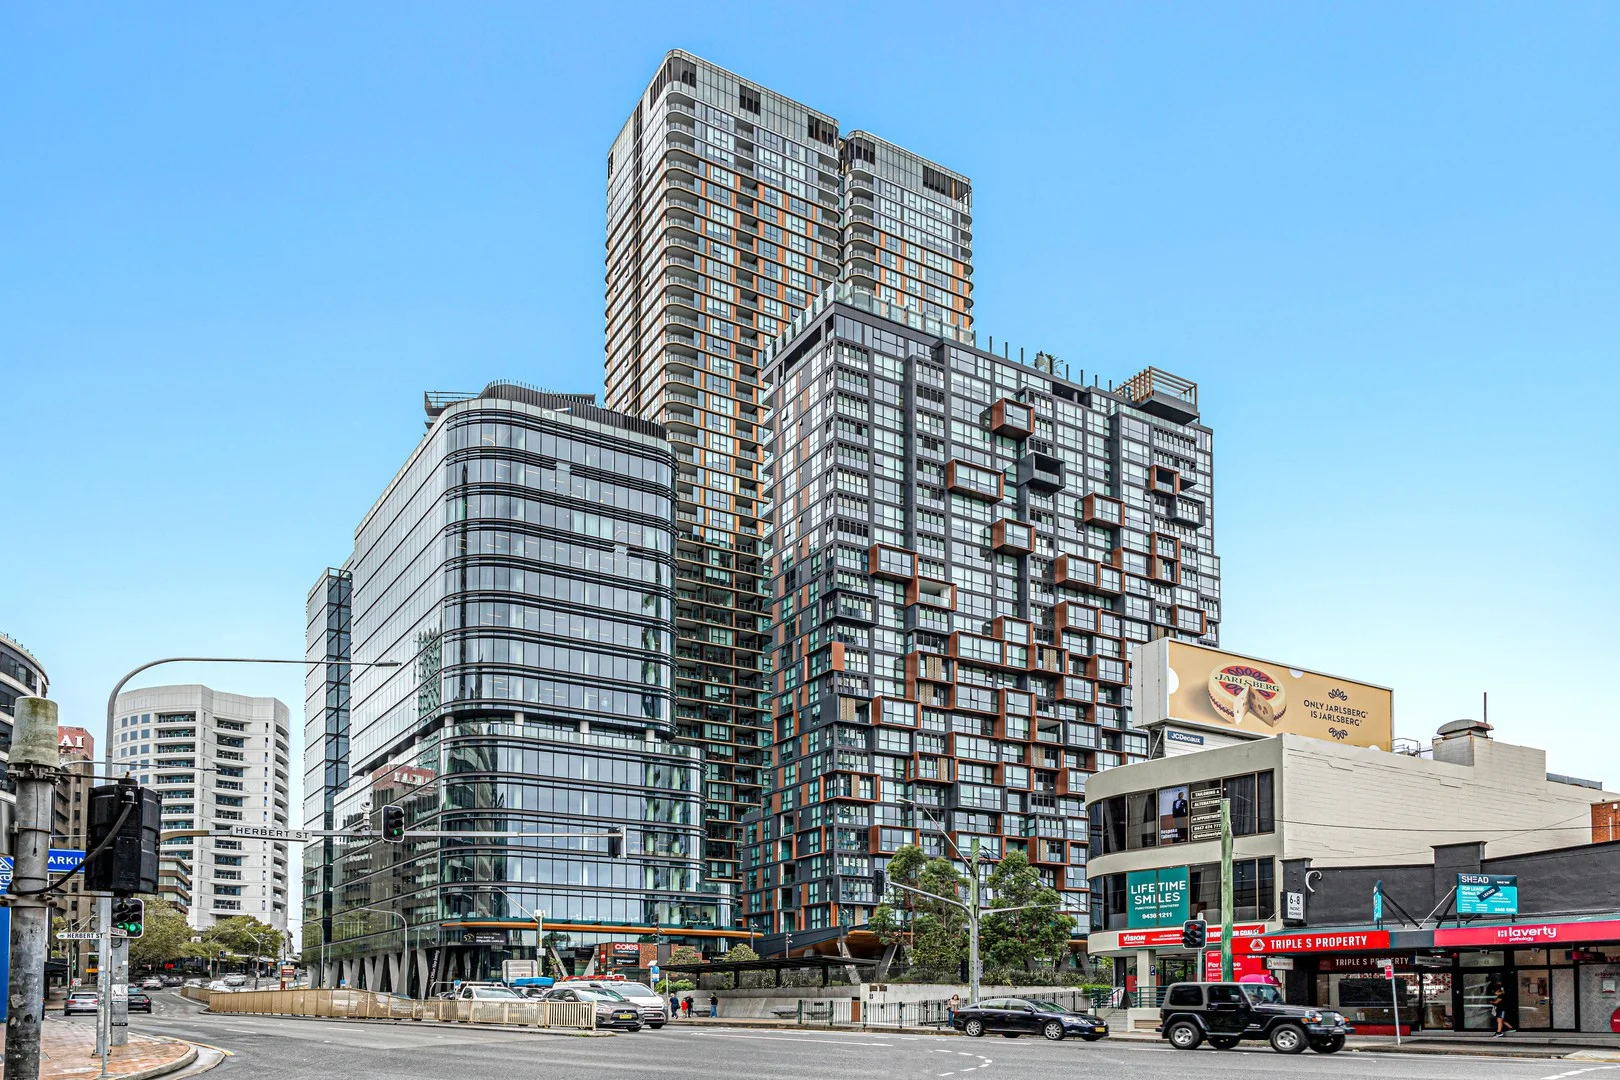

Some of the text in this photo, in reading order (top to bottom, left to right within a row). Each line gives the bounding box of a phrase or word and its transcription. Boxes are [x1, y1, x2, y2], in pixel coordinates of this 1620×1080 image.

[1215, 673, 1280, 692] JARLSBERG
[1304, 699, 1324, 710] ONLY
[1310, 710, 1318, 719] IS
[1171, 732, 1201, 743] JCDecaux
[235, 826, 310, 839] HERBERT ST
[1461, 875, 1489, 884] SHEAD
[1130, 880, 1187, 895] LIFE TIME
[1134, 891, 1181, 905] SMILES
[1289, 895, 1301, 905] 6-8
[1123, 933, 1146, 942] VISION
[1509, 926, 1557, 938] laverty
[614, 943, 639, 951] coles
[1271, 935, 1368, 949] TRIPLE S PROPERTY
[1335, 958, 1360, 966] TRIPLE
[1362, 957, 1368, 966] S
